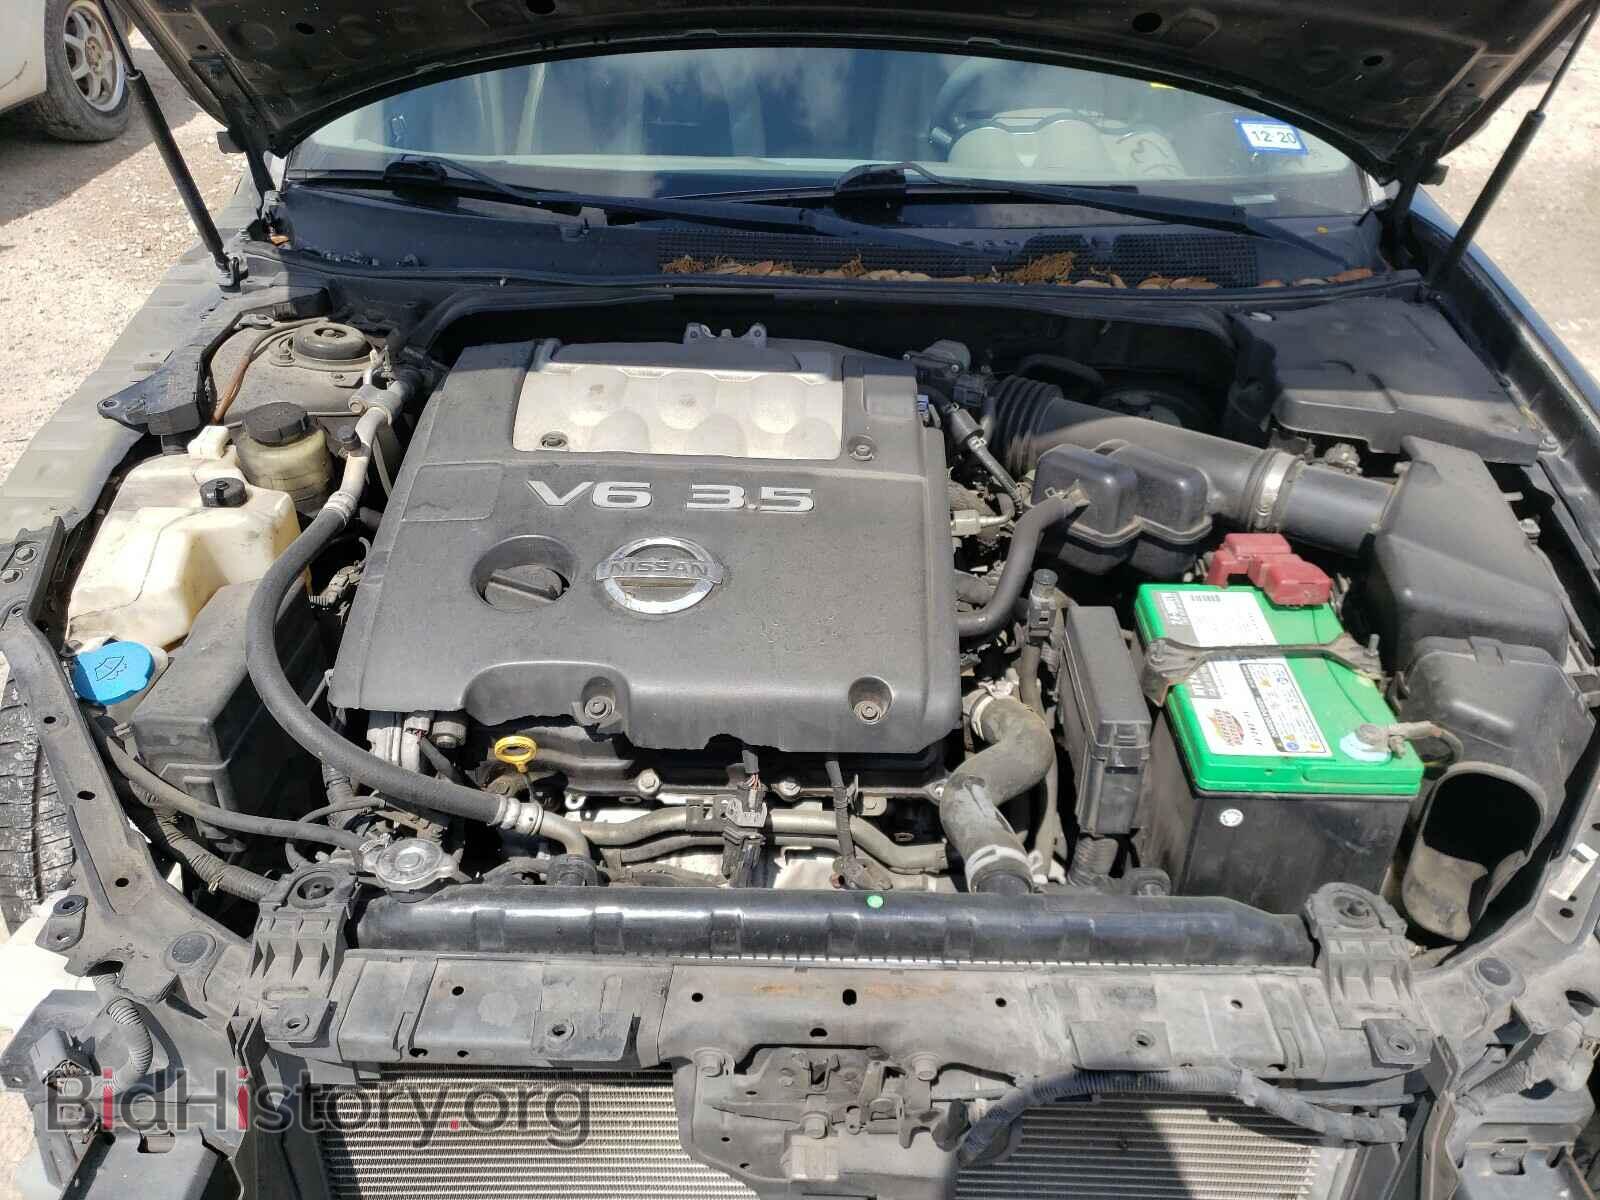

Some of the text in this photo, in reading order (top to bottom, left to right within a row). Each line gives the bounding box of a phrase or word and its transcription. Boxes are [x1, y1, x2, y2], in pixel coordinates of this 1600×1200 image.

[527, 480, 815, 513] V6 3.5
[608, 560, 706, 577] NISSAN
